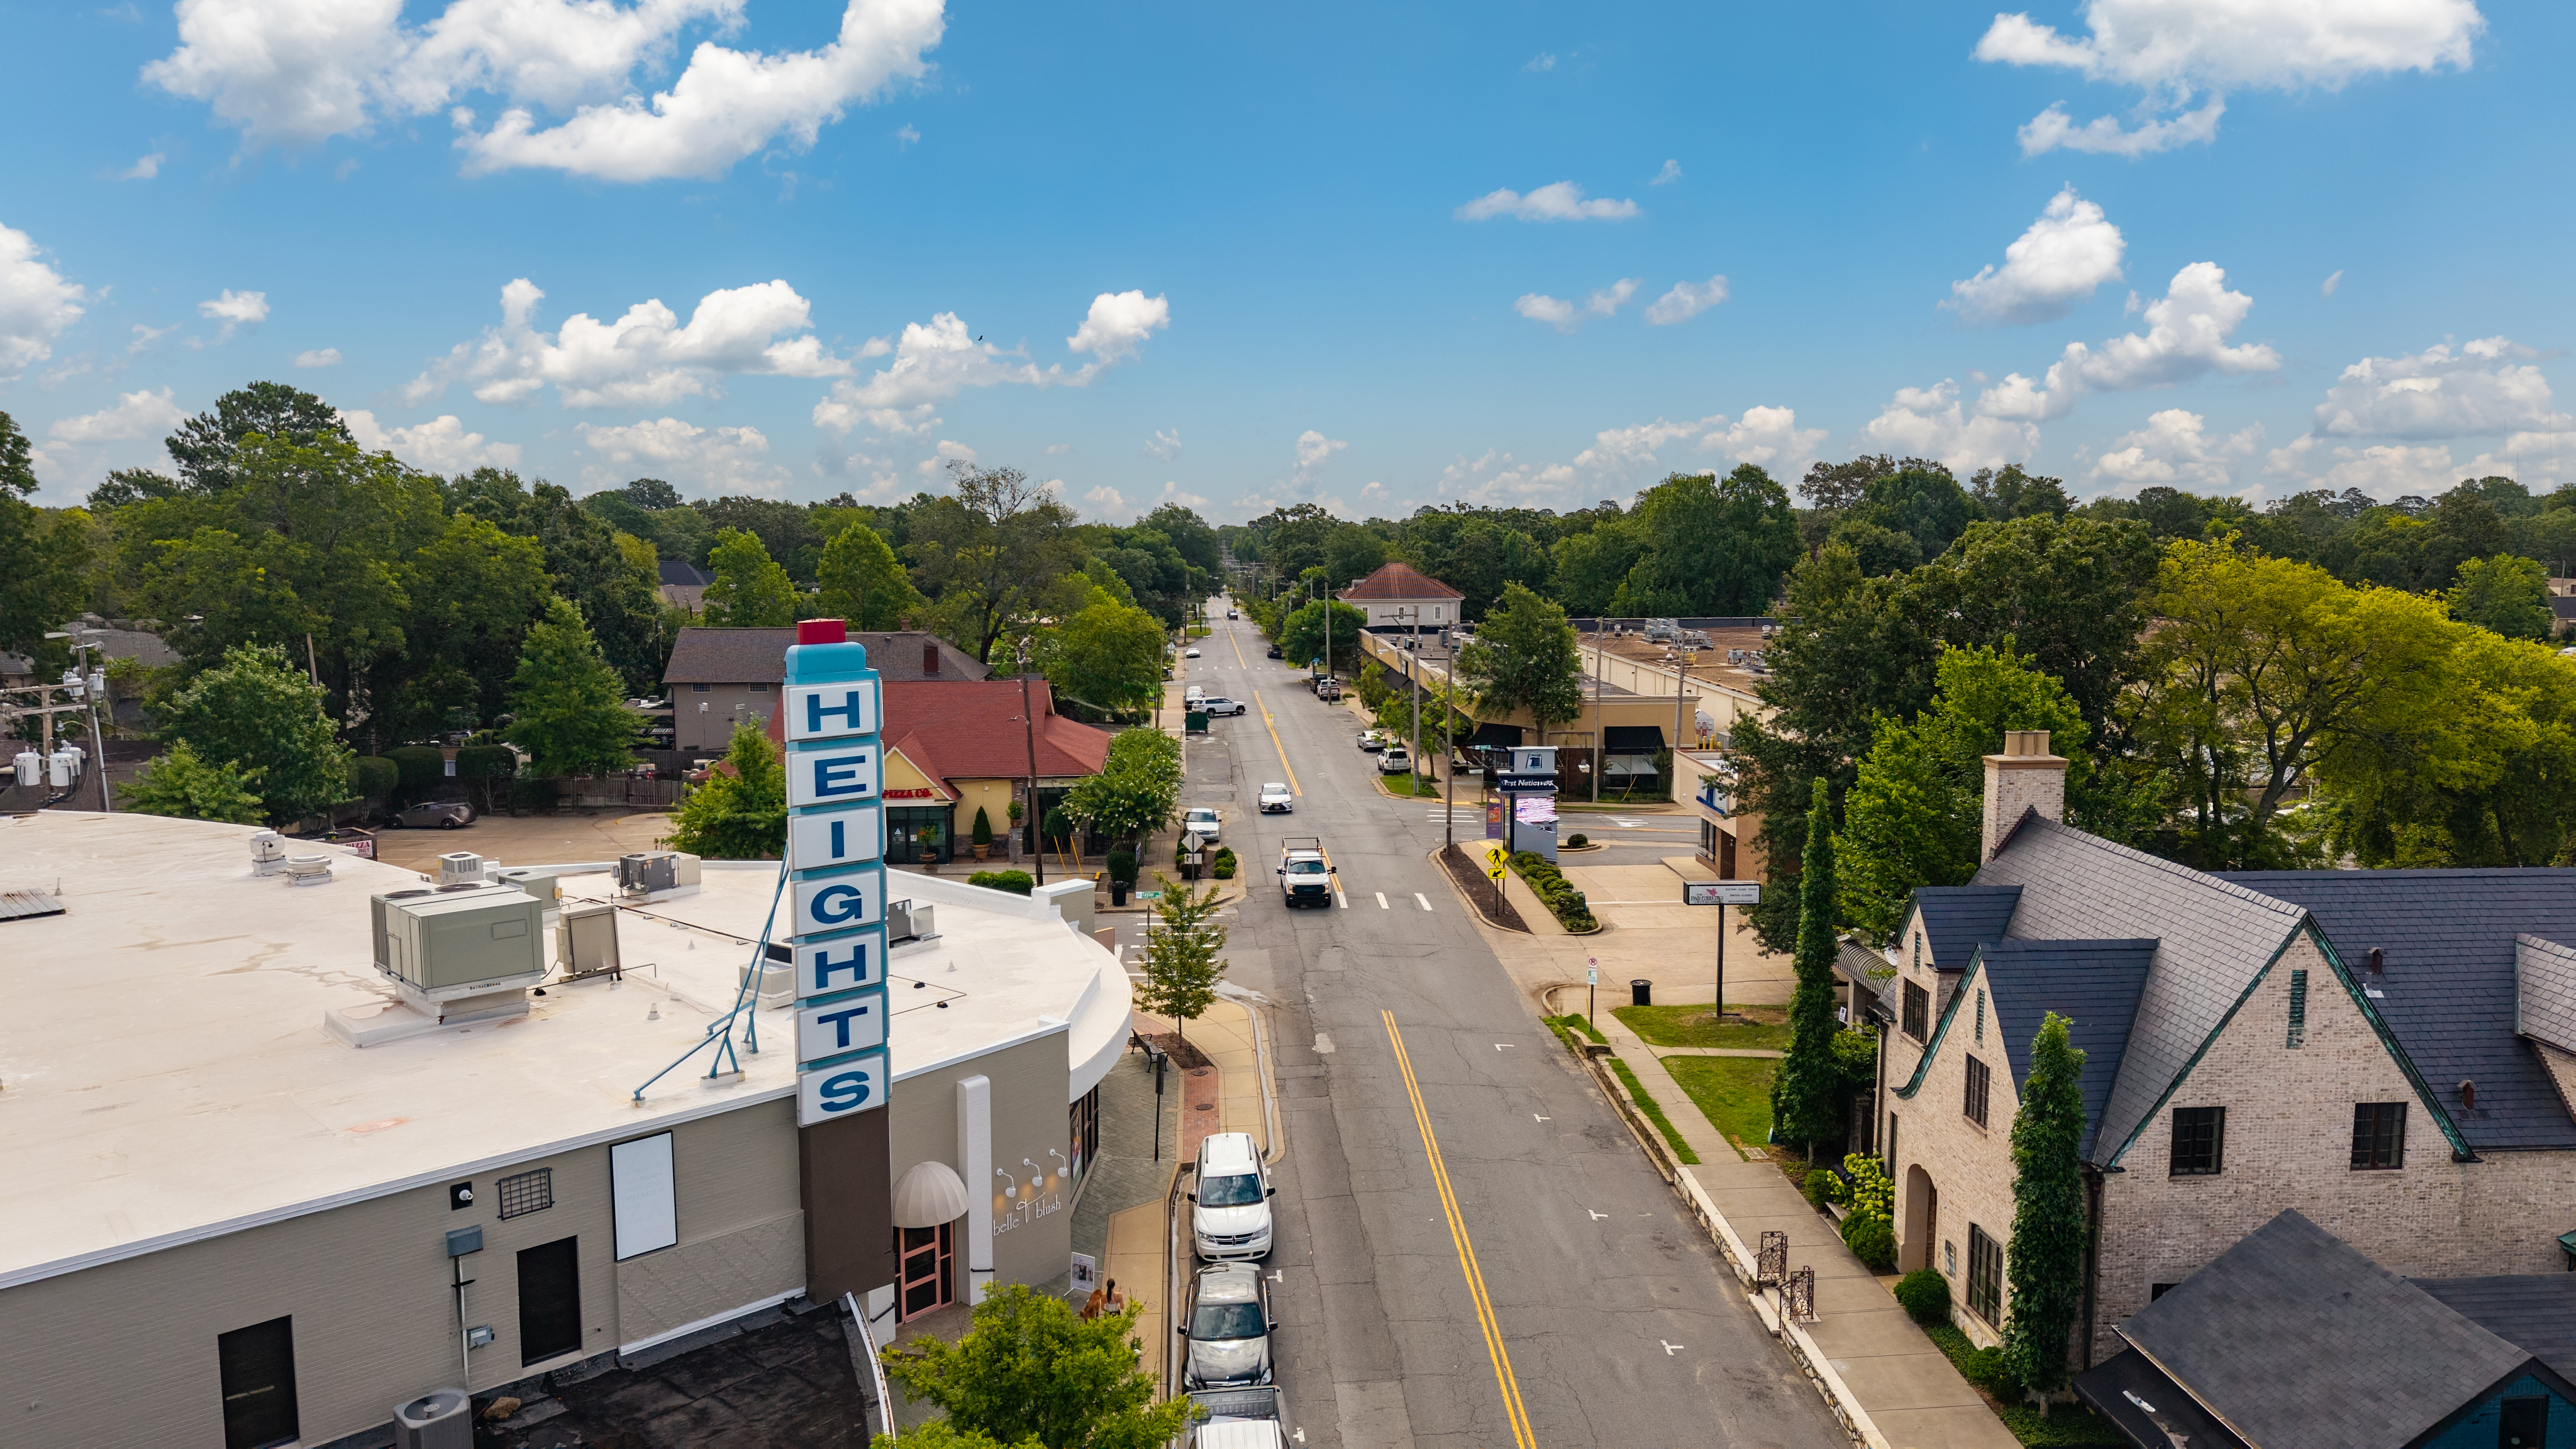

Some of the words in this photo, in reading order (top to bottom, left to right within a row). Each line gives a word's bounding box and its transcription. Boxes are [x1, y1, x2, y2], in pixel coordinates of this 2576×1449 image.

[882, 789, 913, 798] PIZZA
[807, 691, 870, 1113] HEIGHTS
[993, 1211, 1019, 1236] belle
[1036, 1194, 1061, 1219] blush
